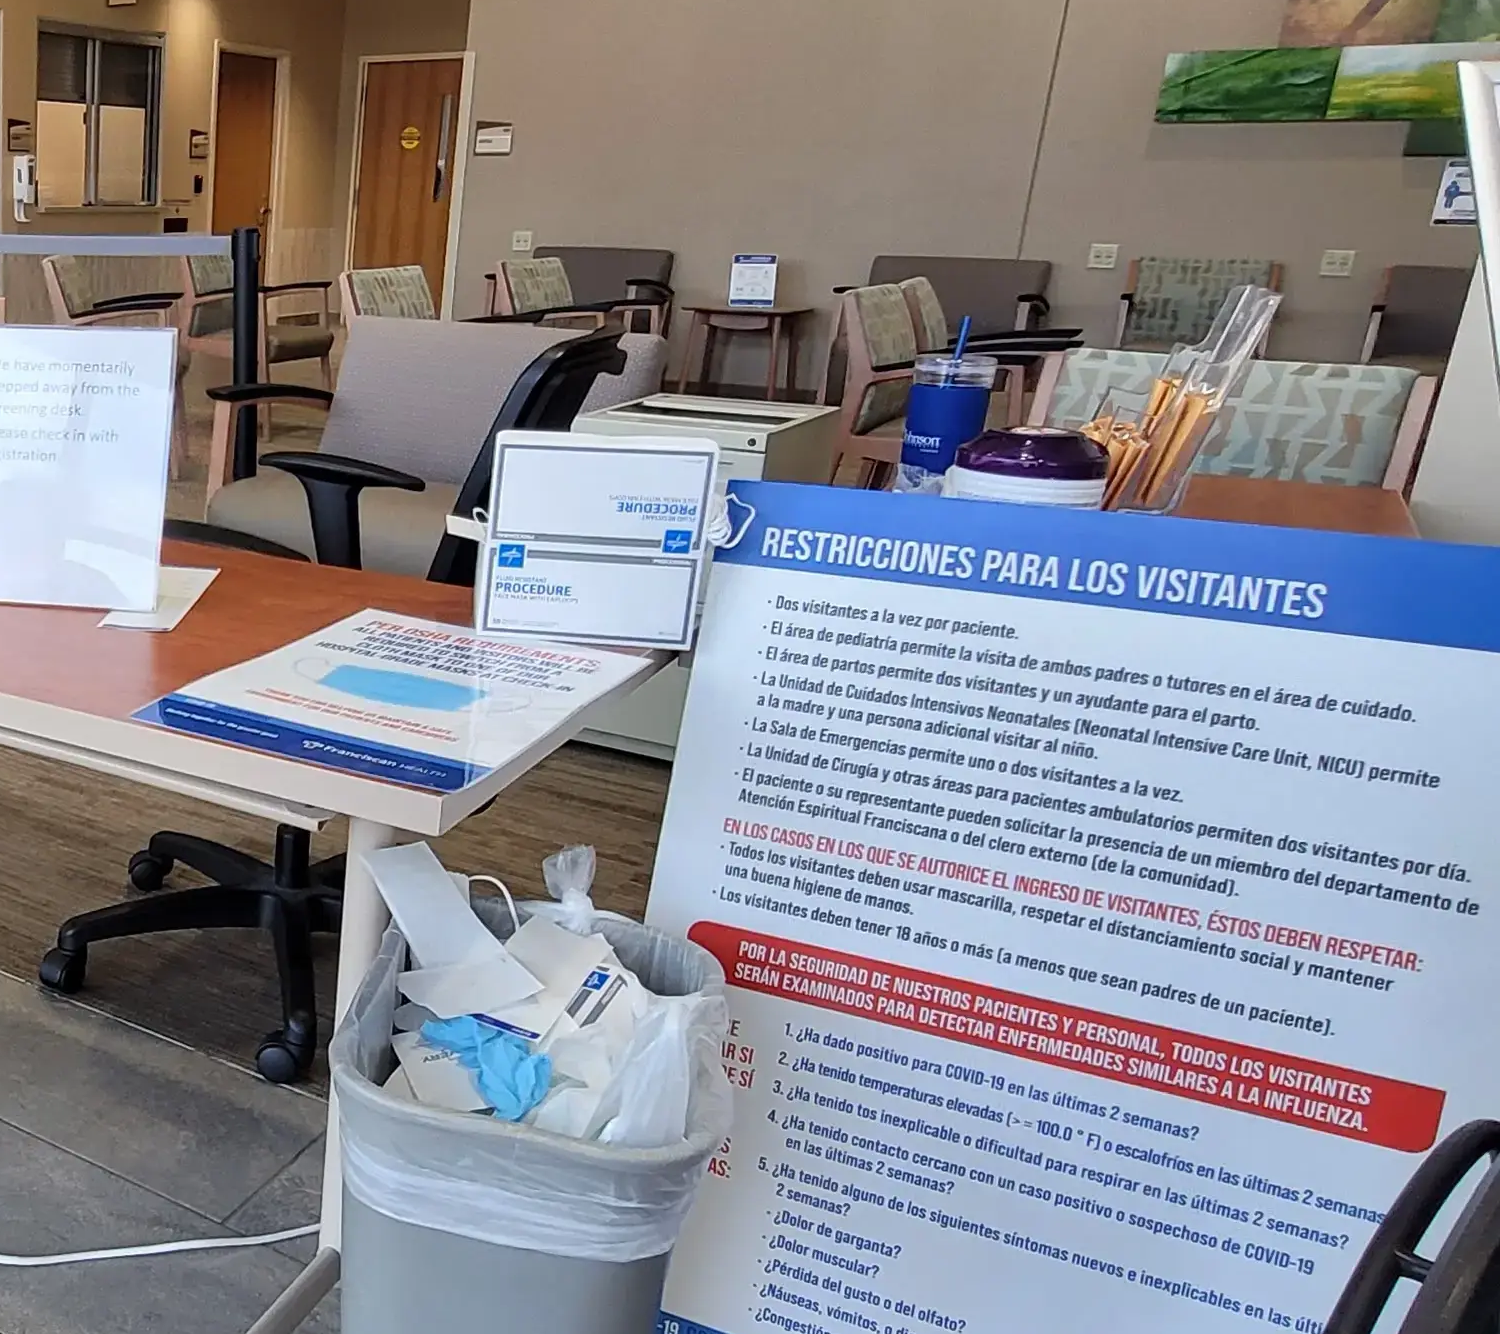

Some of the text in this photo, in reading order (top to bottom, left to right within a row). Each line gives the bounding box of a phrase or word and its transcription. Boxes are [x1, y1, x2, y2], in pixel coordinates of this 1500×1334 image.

[14, 360, 45, 371] have
[49, 361, 136, 376] momentarily
[43, 384, 77, 396] away
[81, 381, 113, 395] from
[117, 384, 140, 396] the
[31, 428, 69, 440] check
[73, 430, 86, 441] in
[89, 431, 119, 443] with
[616, 502, 697, 515] PROCEDURE
[496, 582, 572, 596] PROCEDURE
[762, 527, 1326, 617] RESTRICCIONES PARA LOS VISITANTES
[404, 627, 450, 641] OSHA
[775, 595, 1018, 638] Dos visitantes a la vez por paciente.
[380, 631, 441, 647] PATIENTS
[443, 643, 473, 652] AND
[474, 649, 538, 663] VISITORS
[402, 651, 442, 662] MASK
[428, 662, 478, 676] MASKS
[324, 744, 398, 768] Franciscan
[752, 717, 1182, 802] La Sala de Emergencias permite uno o dos visitantes a la vez.
[723, 817, 1423, 971] EN LOS CASOS EN LOS QUE SE AUTORICE EL INGRESO DE VISITANTES, ÉSTOS DEBEN RESPETAR:
[739, 941, 1371, 1104] POR LA SEGURIDAD DE NUESTROS PACIENTES Y PERSONAL, TODOS LOS VISITANTES
[734, 962, 1367, 1131] SERÁN EXAMINADOS PARA DETECTAR ENFERMEDADES SIMILARES A LA INFLUENZA.
[785, 1023, 1199, 1139] 1. ¿Ha dado positivo para COVID-19 en las últimas 2 semanas?
[769, 1234, 879, 1277] ¿Dolor muscular?
[773, 1210, 901, 1258] ¿Dolor de garganta?
[759, 1283, 821, 1314] ¿Náuseas,
[827, 1306, 879, 1334] vómitos,
[764, 1259, 965, 1332] ¿Pérdida del gusto o del olfato?
